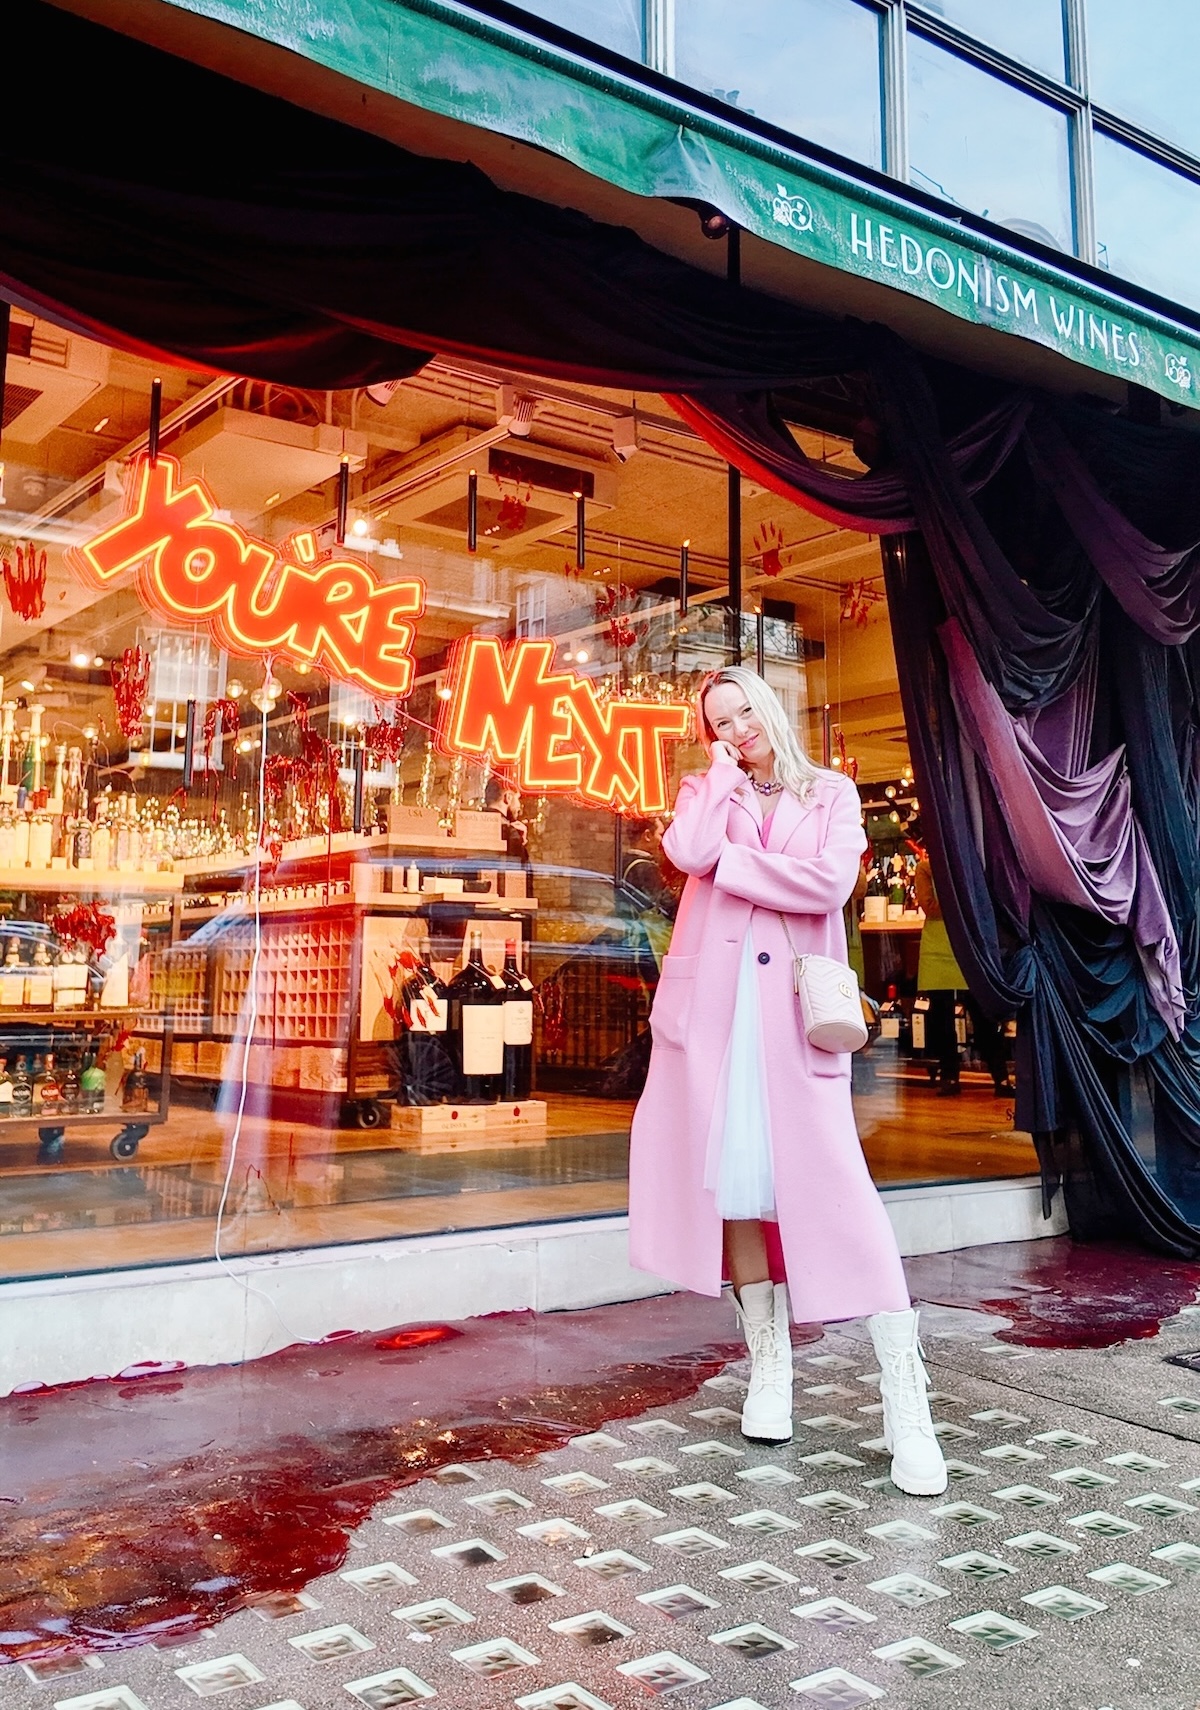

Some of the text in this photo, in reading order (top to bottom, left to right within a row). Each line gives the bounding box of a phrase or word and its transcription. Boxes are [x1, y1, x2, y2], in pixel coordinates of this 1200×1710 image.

[850, 213, 1140, 367] HEDONISM WINES
[82, 457, 421, 693] YOU'RE
[453, 640, 690, 812] NEXT
